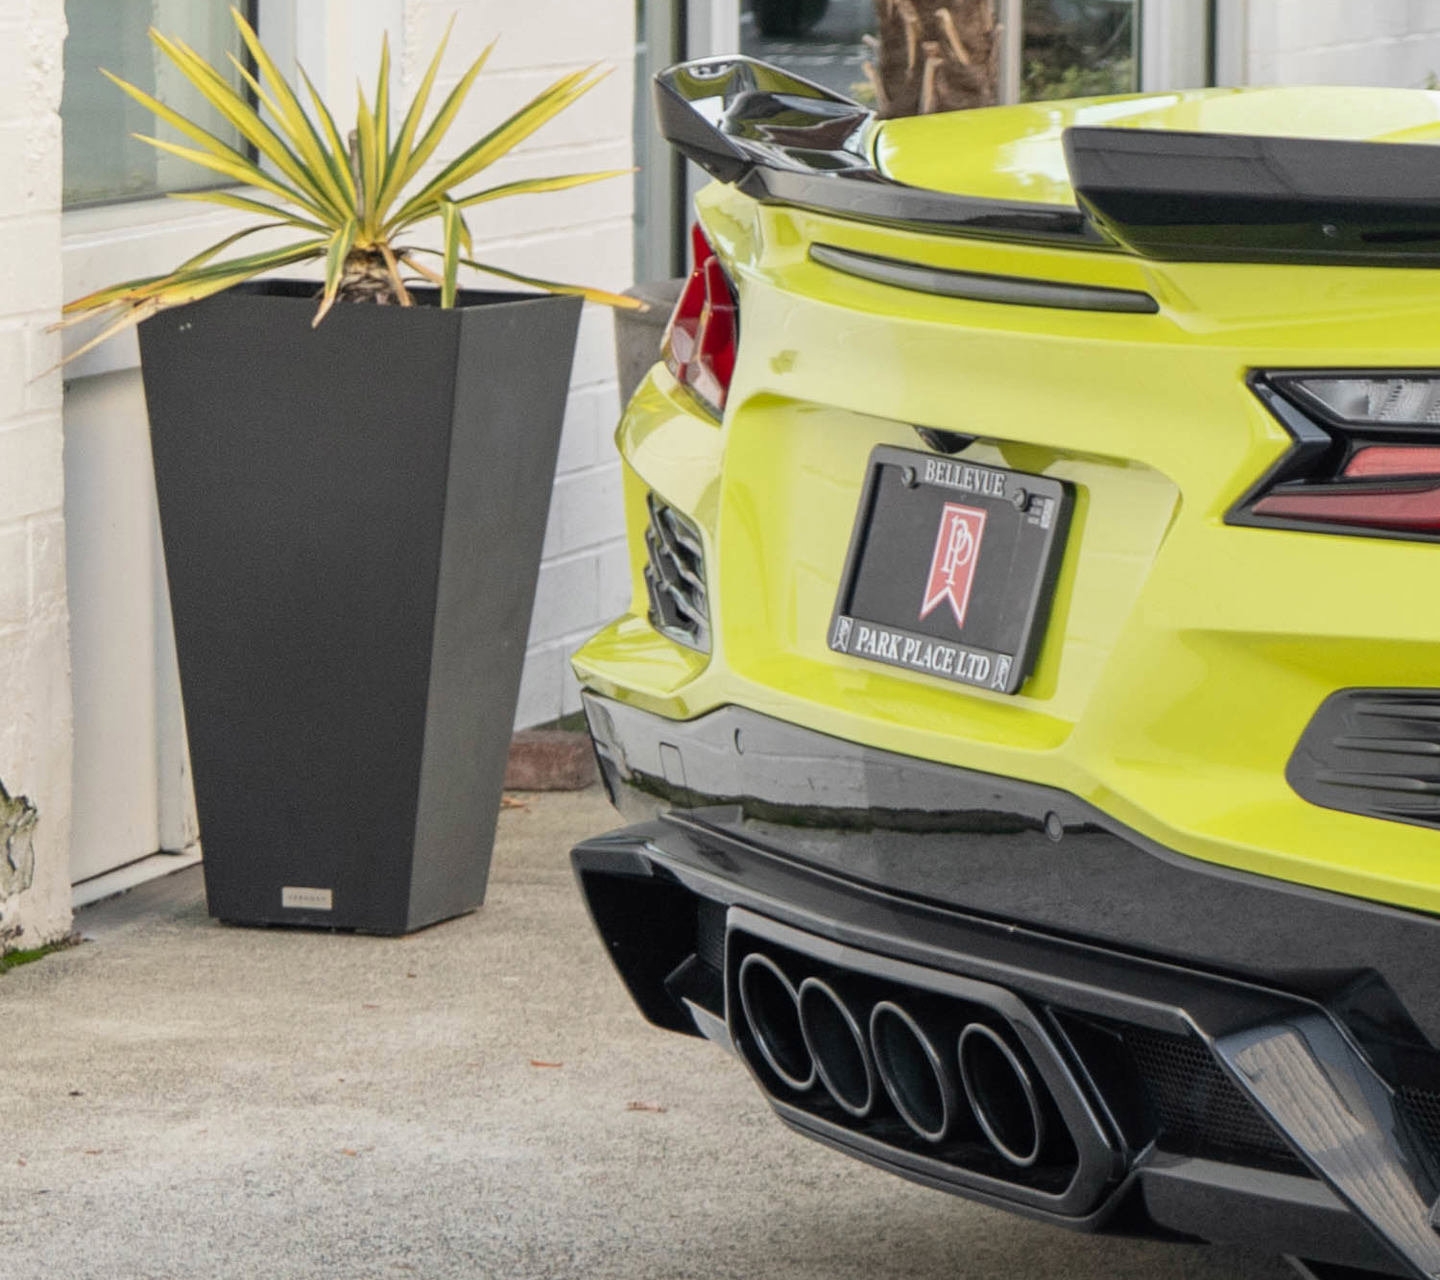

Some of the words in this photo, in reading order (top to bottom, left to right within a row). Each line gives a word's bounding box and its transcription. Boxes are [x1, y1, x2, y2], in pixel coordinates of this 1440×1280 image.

[924, 459, 1006, 496] BELLEVUE
[855, 626, 899, 660] PARK
[901, 636, 954, 674] PLACE
[955, 651, 991, 681] LTD
